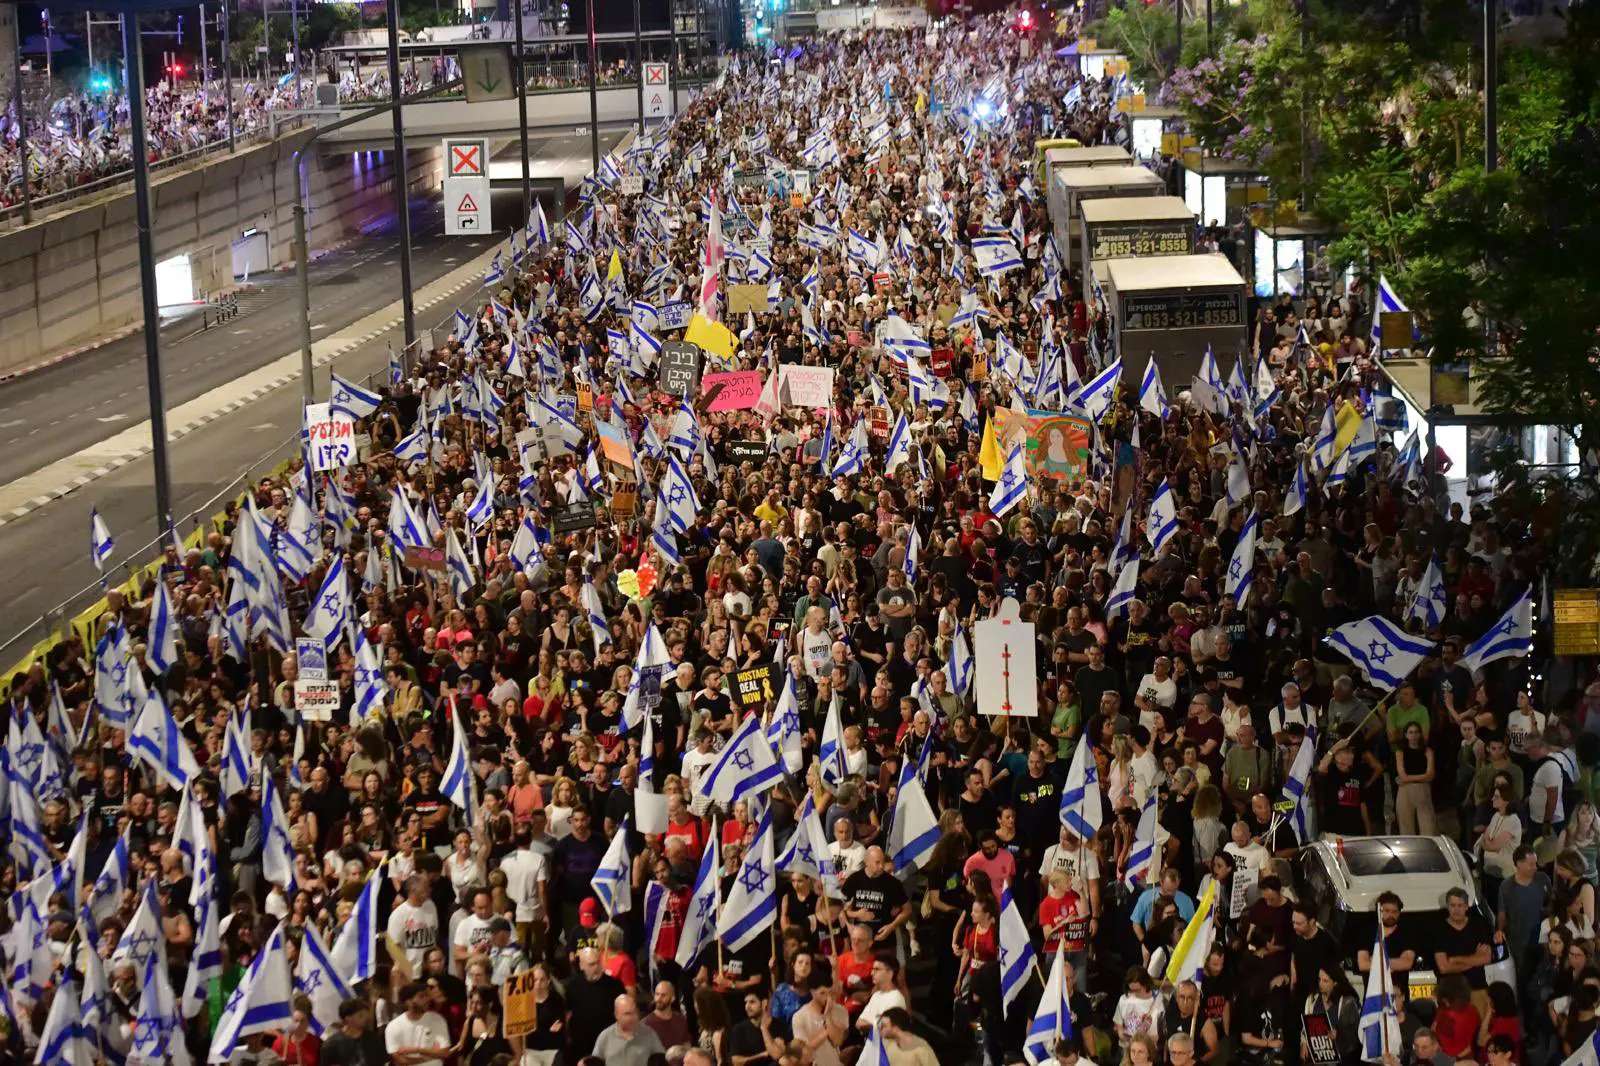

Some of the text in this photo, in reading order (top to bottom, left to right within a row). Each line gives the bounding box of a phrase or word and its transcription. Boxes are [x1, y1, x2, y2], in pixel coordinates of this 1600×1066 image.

[1110, 240, 1188, 254] 053-521-8558
[1143, 309, 1237, 328] 053-521-8558
[665, 350, 696, 367] ביבי
[667, 370, 692, 382] סרבן
[576, 382, 591, 392] 7.10
[669, 381, 687, 389] גיוס
[615, 482, 636, 493] 7.10
[737, 667, 770, 682] HOSTAGE
[739, 681, 760, 693] DEAL
[742, 691, 761, 704] NOW
[1057, 858, 1075, 868] אתה
[506, 974, 535, 996] 7.10
[1310, 1036, 1333, 1050] העם
